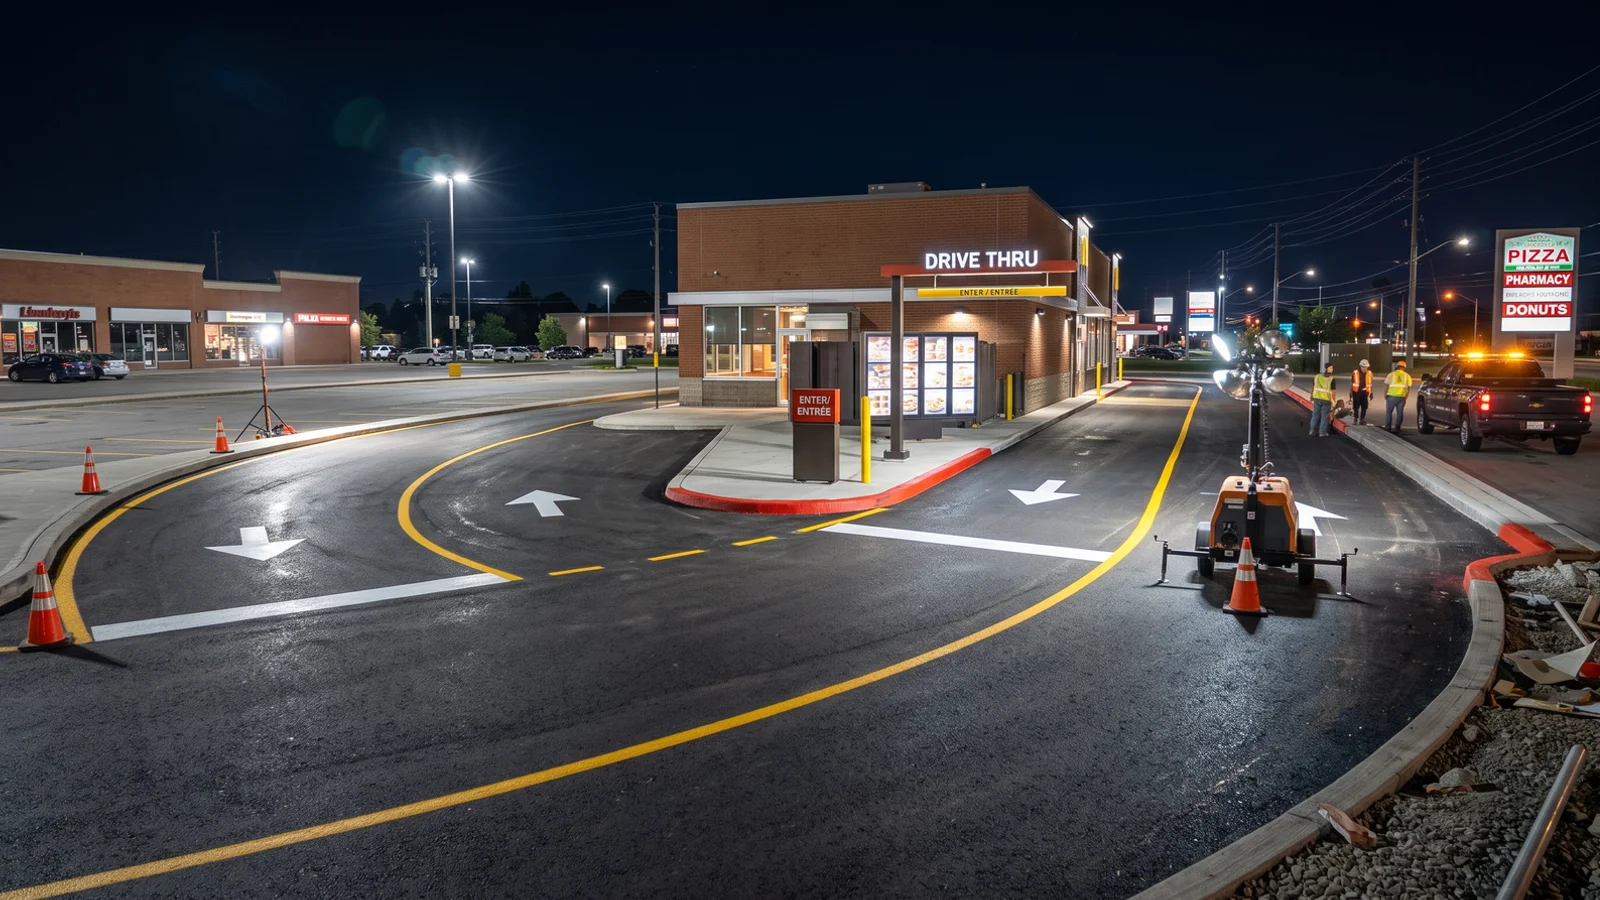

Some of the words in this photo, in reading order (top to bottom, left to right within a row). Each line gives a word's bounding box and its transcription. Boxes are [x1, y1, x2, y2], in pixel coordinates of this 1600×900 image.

[925, 252, 981, 270] DRIVE
[985, 250, 1038, 268] THRU
[1508, 249, 1570, 263] PIZZA
[1506, 274, 1570, 285] PHARMACY
[990, 288, 1018, 296] ENTRÉE
[1506, 304, 1568, 315] DONUTS
[799, 395, 831, 404] ENTER/
[797, 405, 831, 416] ENTRÉE
